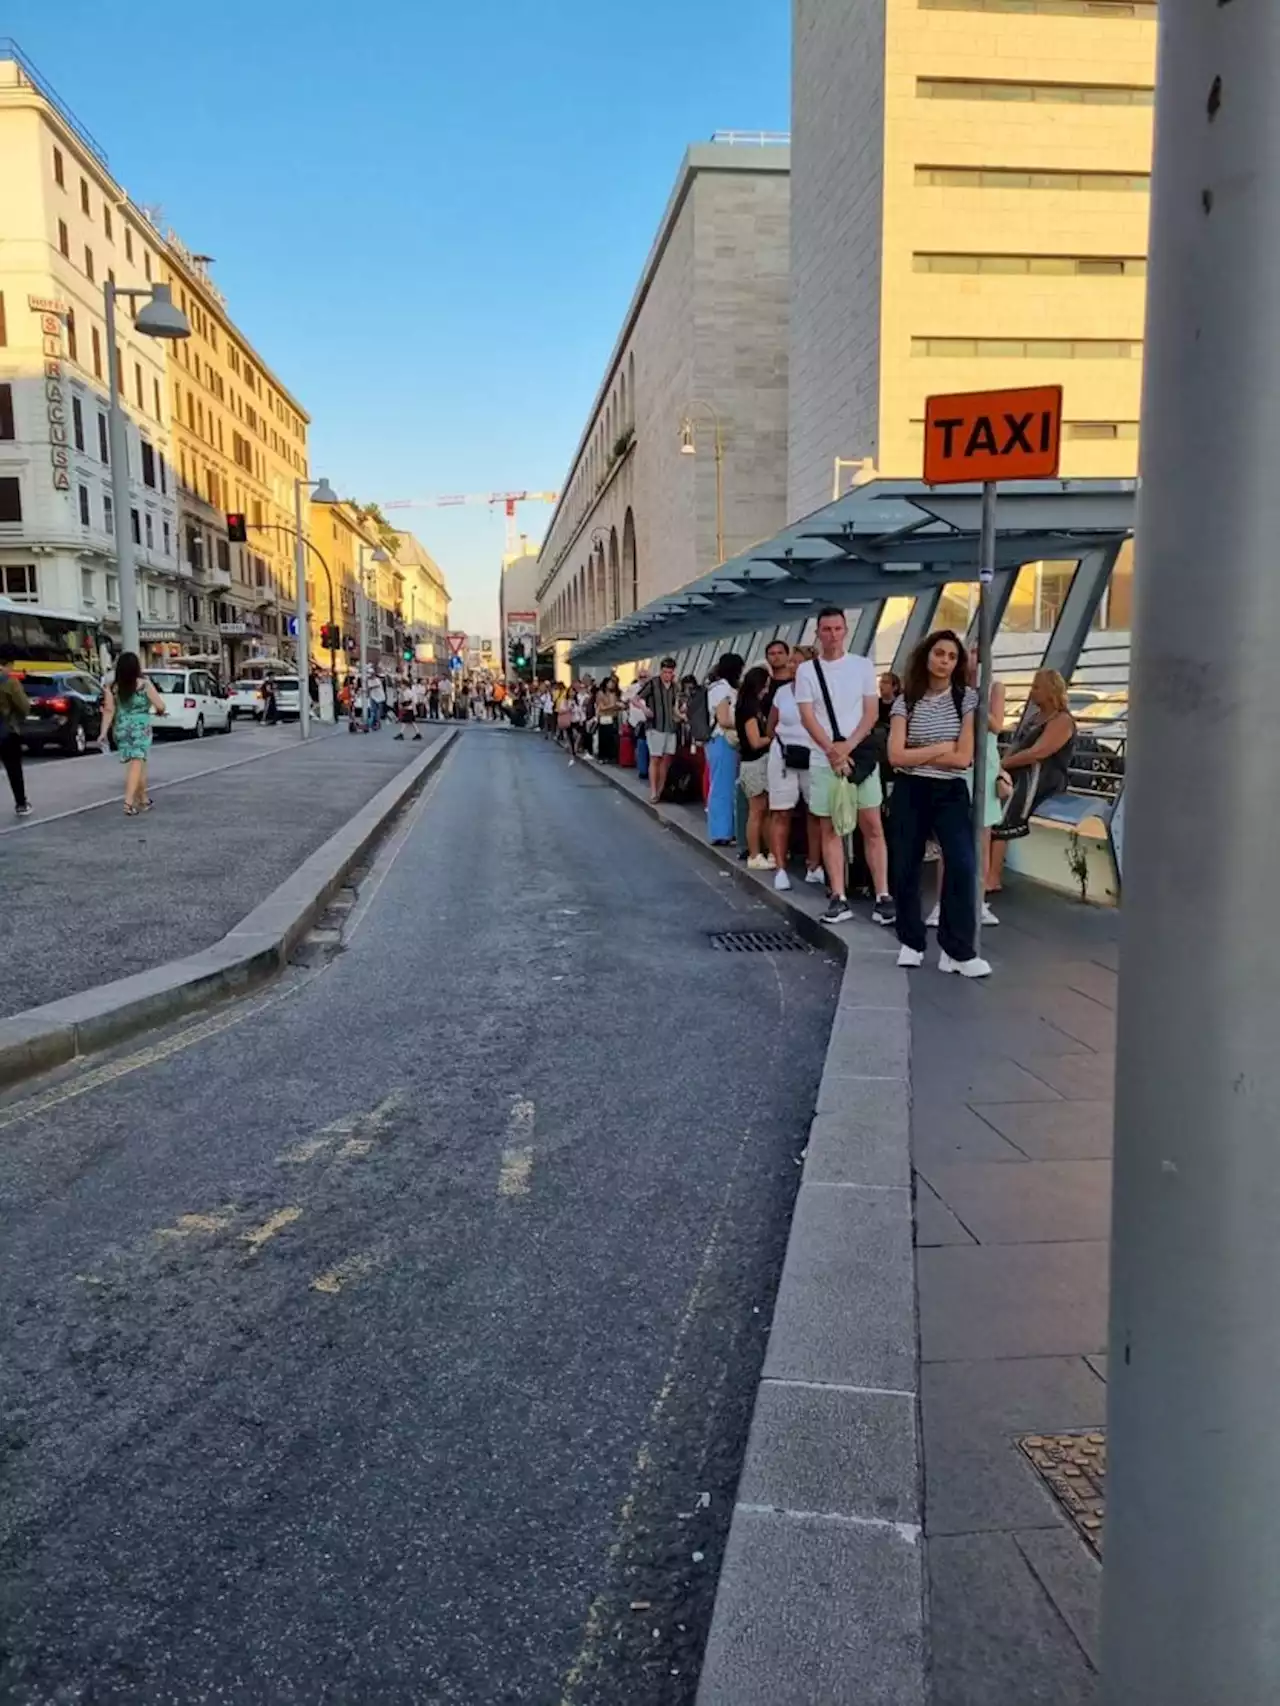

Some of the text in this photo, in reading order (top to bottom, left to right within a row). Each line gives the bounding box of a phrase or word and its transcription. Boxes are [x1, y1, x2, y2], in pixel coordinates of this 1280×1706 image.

[31, 296, 65, 310] HOTEL
[45, 316, 69, 488] SIRACUSA
[934, 411, 1051, 459] TAXI
